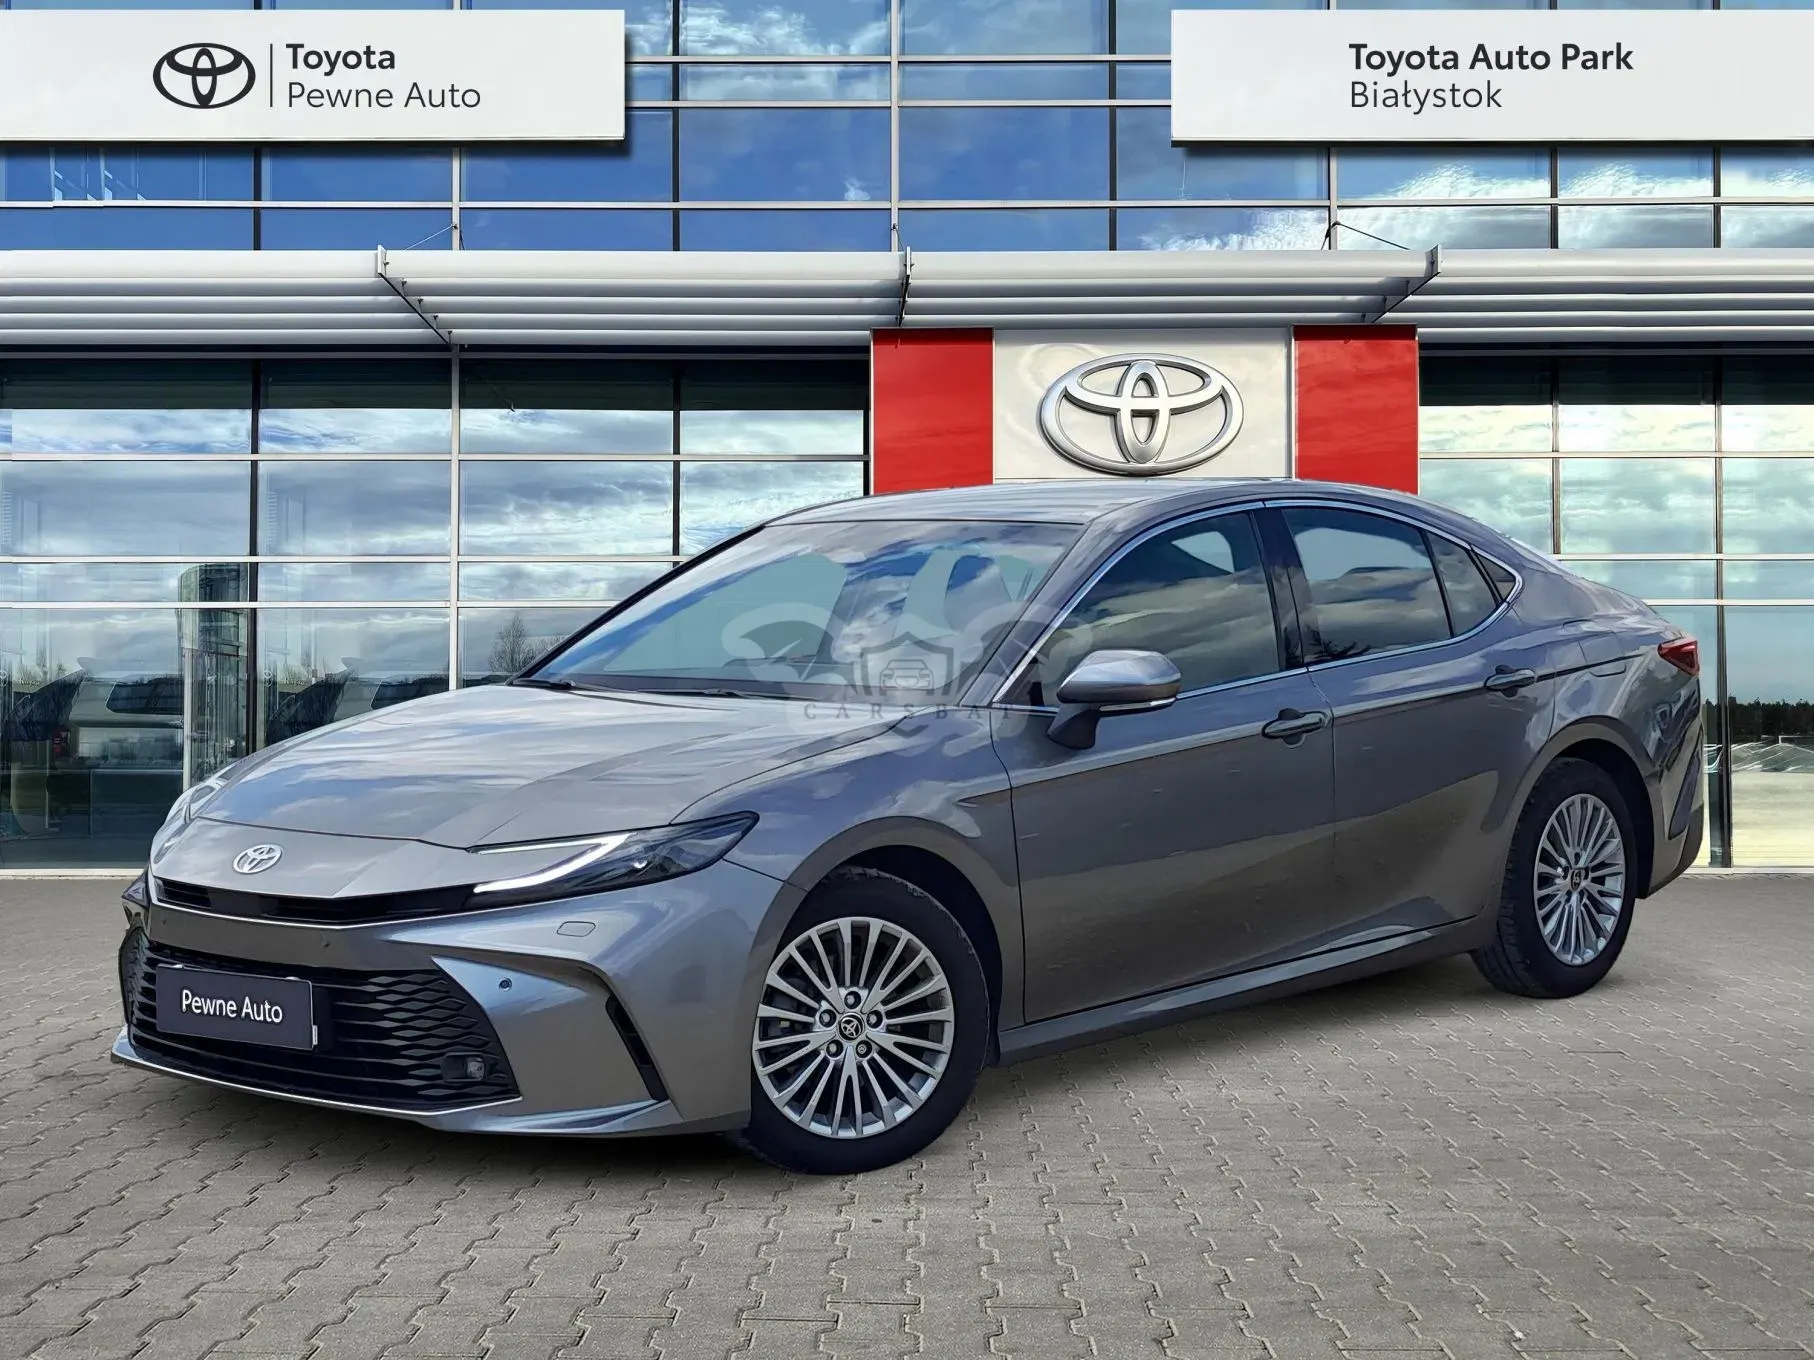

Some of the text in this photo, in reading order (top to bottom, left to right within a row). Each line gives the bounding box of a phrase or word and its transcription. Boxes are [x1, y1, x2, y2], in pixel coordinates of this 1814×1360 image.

[285, 43, 396, 77] Toyota
[1348, 41, 1634, 78] Toyota Auto Park
[288, 81, 481, 108] Pewne Auto
[1350, 79, 1503, 116] Białystok
[182, 989, 283, 1023] Pewne Auto
